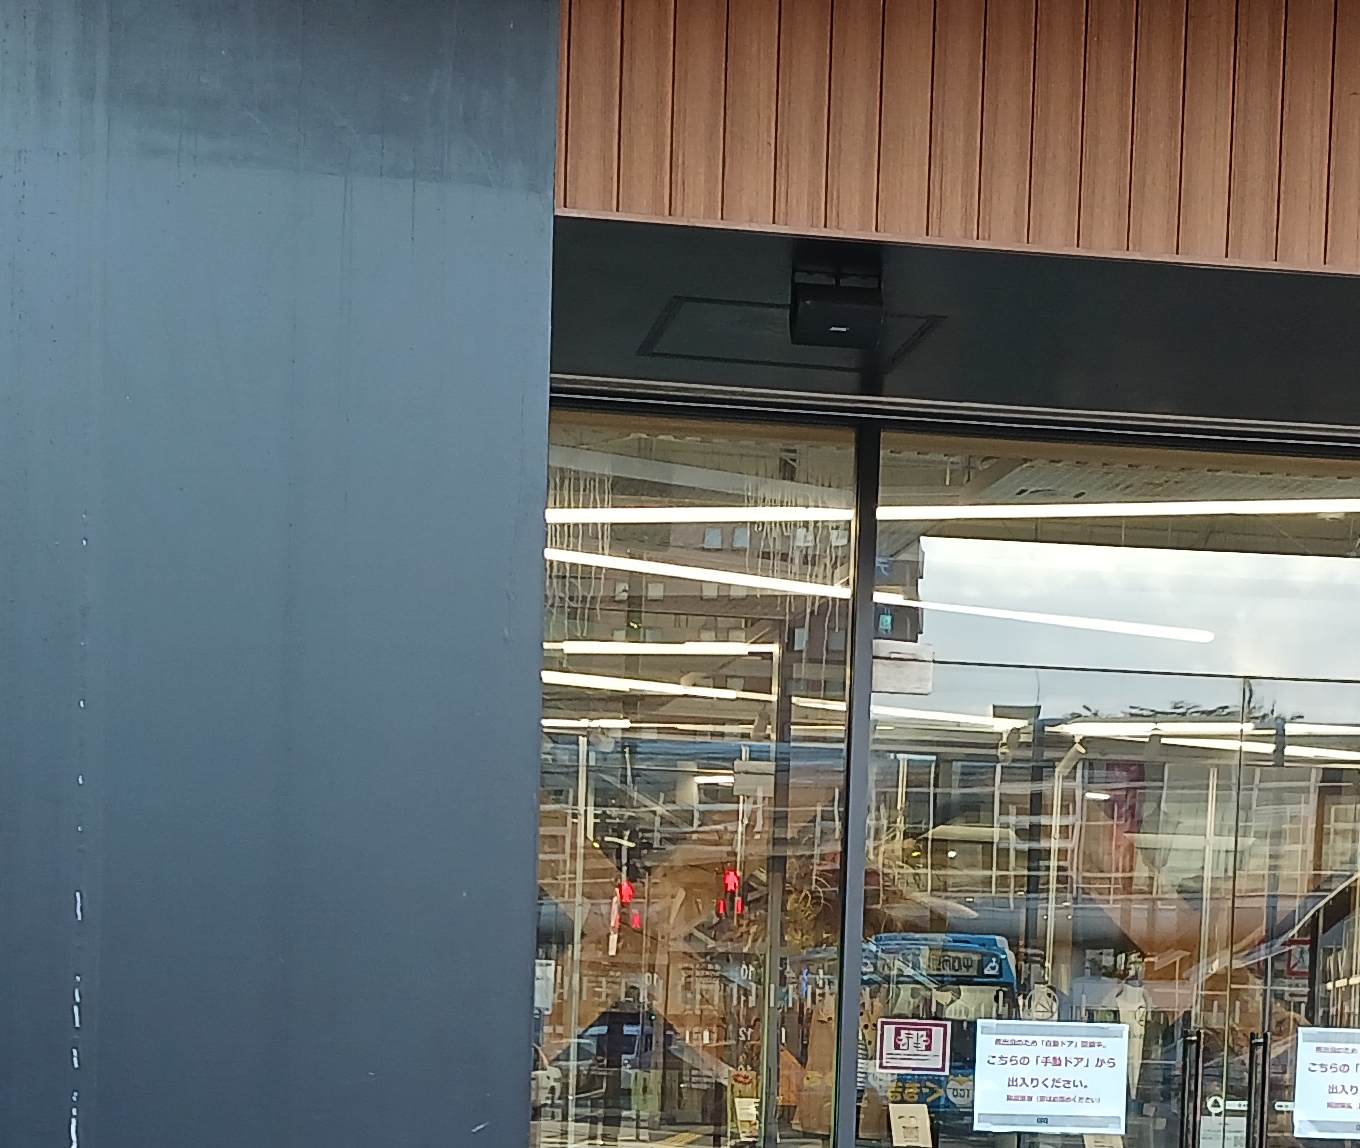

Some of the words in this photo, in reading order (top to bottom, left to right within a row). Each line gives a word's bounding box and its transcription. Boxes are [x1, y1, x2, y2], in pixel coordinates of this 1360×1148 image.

[986, 1055, 1116, 1068] こちらの「手動ドア」から
[1007, 1076, 1088, 1089] 出入りください。
